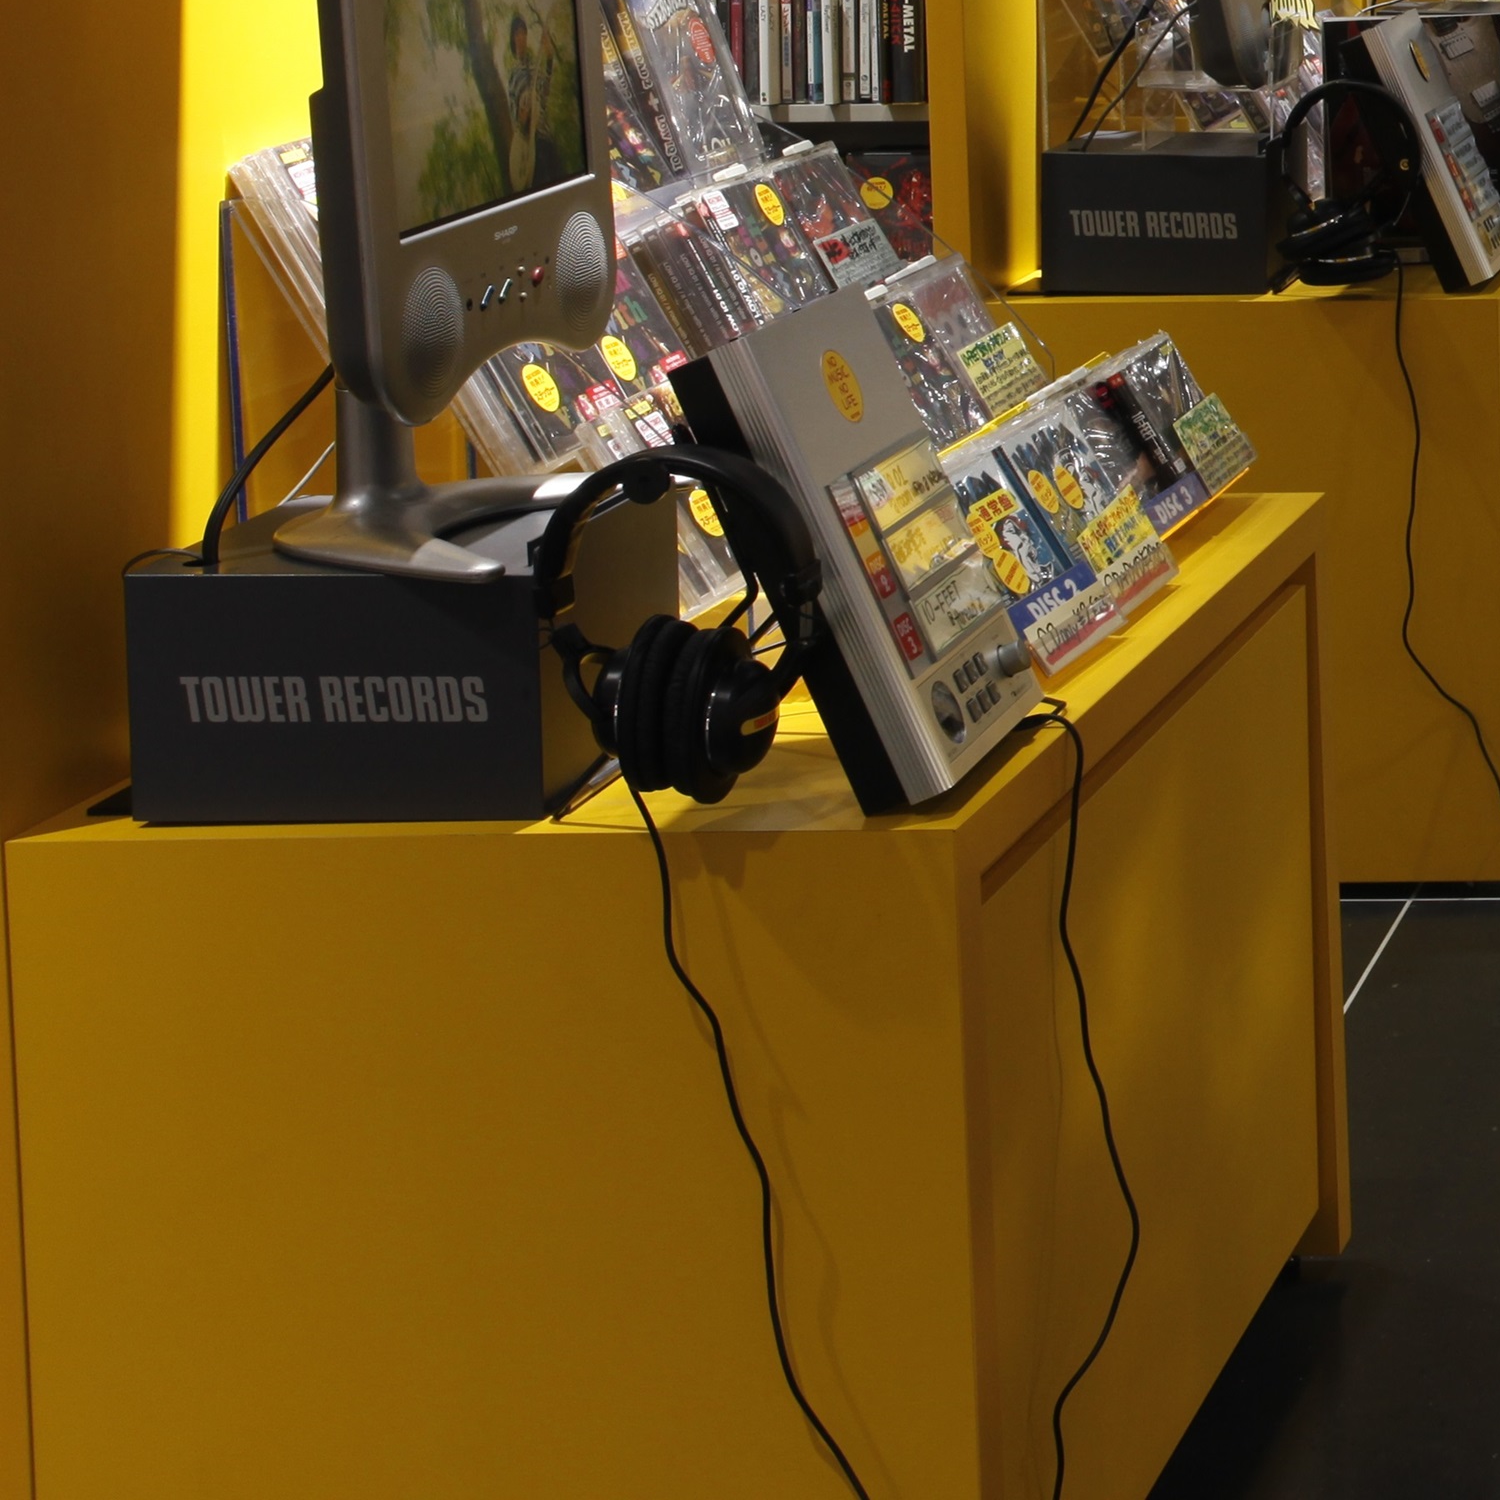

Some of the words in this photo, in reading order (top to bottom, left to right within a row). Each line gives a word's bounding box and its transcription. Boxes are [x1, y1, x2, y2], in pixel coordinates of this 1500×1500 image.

[494, 224, 518, 240] SHARP
[1069, 209, 1141, 238] TOWER
[1146, 210, 1238, 240] RECORDS
[827, 365, 849, 387] MUSIC
[1131, 411, 1155, 442] 10-FEET
[977, 494, 1015, 523] 通常盤
[1154, 496, 1182, 525] DISC
[1181, 485, 1194, 504] 3
[919, 579, 963, 626] 10-FEET
[1026, 589, 1063, 622] DISC
[180, 676, 311, 723] TOWER
[319, 676, 489, 723] RECORDS
